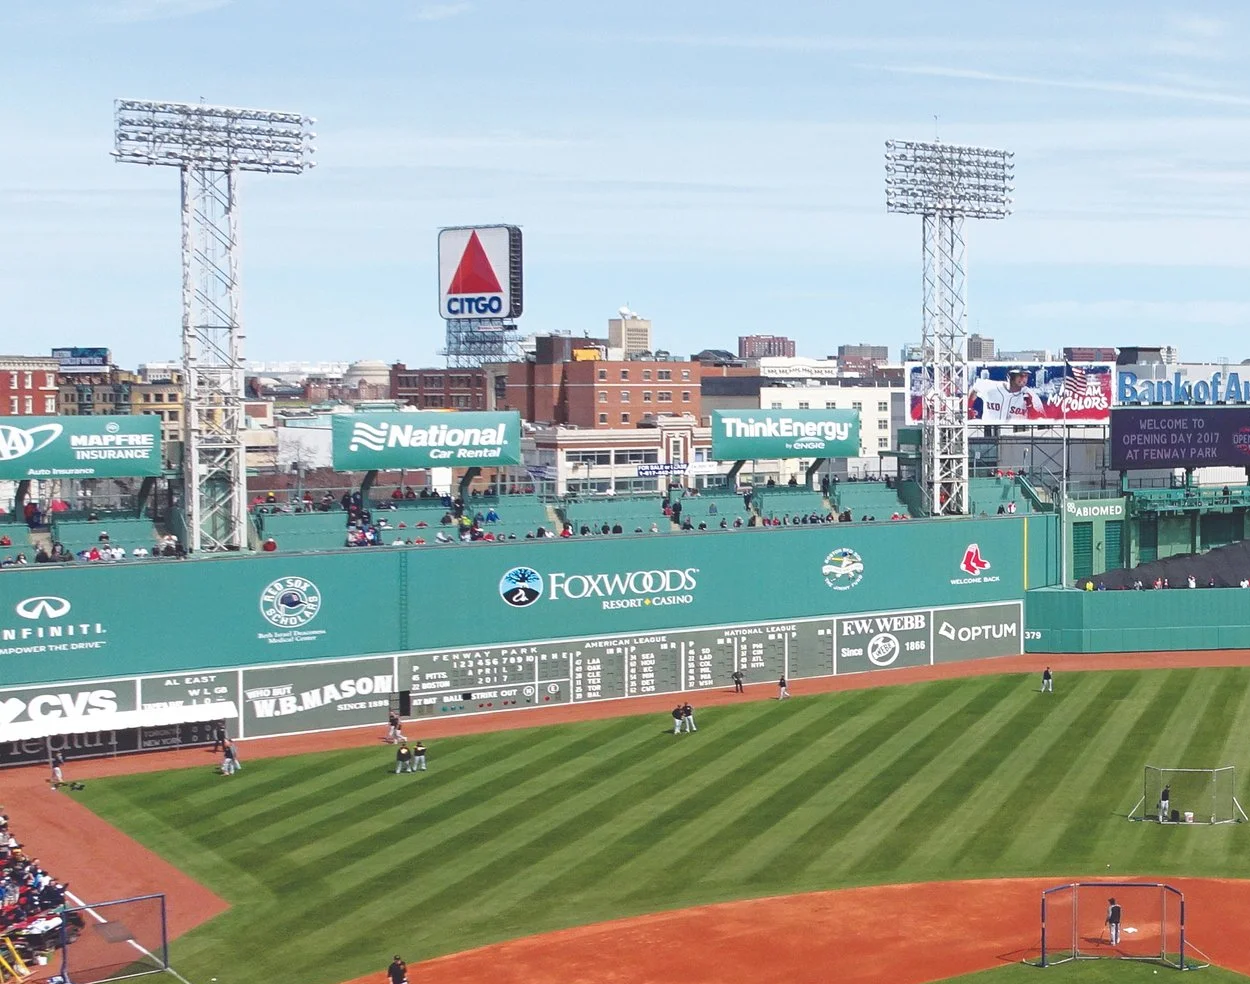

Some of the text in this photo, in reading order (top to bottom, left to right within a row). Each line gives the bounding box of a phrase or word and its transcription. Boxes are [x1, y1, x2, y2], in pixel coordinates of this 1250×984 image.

[447, 296, 502, 314] CITGO
[1118, 371, 1190, 402] Bank
[1193, 371, 1221, 403] of
[1061, 397, 1109, 413] COLORS
[722, 417, 849, 441] ThinkEnergy
[1140, 419, 1204, 430] WELCOME TO
[70, 434, 154, 446] MAPFRE
[387, 423, 507, 448] National
[1122, 432, 1220, 445] OPENING DAY 2017
[76, 450, 149, 460] INSURANCE
[429, 448, 501, 459] Car Rental
[1126, 448, 1217, 460] AT FENWAY PARK
[1076, 505, 1122, 517] ABIOMED
[264, 578, 311, 602] RED SOX
[548, 568, 697, 600] FOXWOODS
[602, 595, 693, 610] RESORT CASINO
[265, 595, 318, 625] SCHOLARS
[3, 623, 102, 640] NFINITI
[724, 624, 796, 636] NATIONAL LEAGUE
[842, 615, 926, 636] F.W. WEBB
[958, 623, 1016, 642] OPTUM
[0, 642, 101, 655] MPOWER THE DRIVE
[585, 636, 667, 648] AMERICAN LEAGUE
[841, 640, 926, 657] Since 1866
[433, 647, 538, 662] FENWAY PARK
[185, 676, 216, 684] EAST
[422, 681, 450, 689] BOSTON
[245, 686, 293, 699] WHO BUT
[443, 694, 463, 703] BALL
[471, 691, 498, 700] STRIKE
[500, 689, 517, 697] OUT
[28, 689, 118, 721] CVS
[337, 700, 389, 711] SINCE 1898
